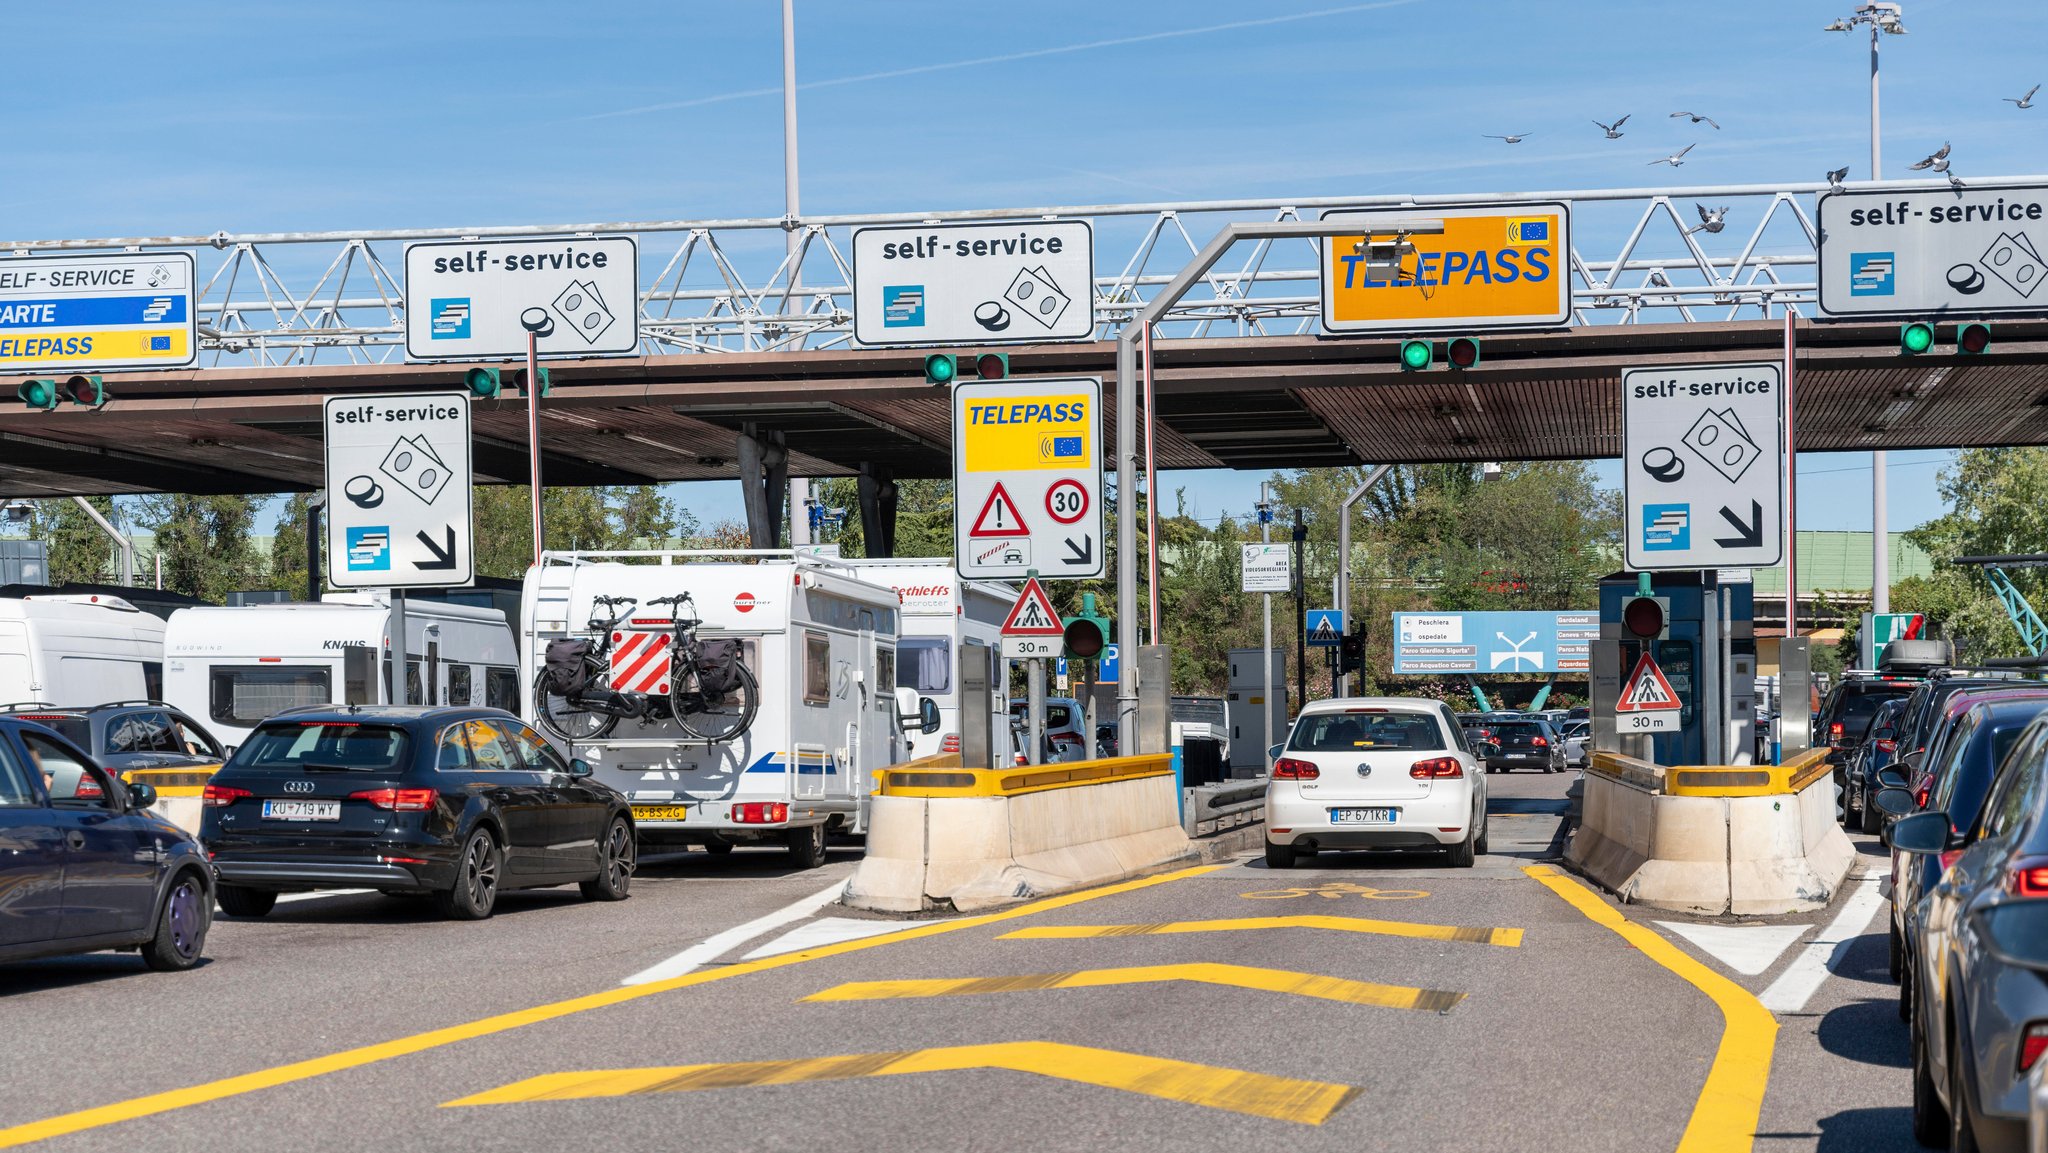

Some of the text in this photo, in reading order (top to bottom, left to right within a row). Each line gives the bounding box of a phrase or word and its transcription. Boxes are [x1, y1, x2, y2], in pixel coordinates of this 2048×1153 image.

[1850, 197, 2043, 226] self-service
[882, 232, 1063, 260] self-service
[433, 247, 608, 274] self-service
[0, 269, 135, 289] ELF-SERVICE
[0, 304, 57, 324] ARTE
[0, 336, 94, 357] ELEPASS
[1634, 376, 1770, 399] self-service
[335, 404, 459, 424] self-service
[970, 402, 1085, 425] TELEPASS
[1054, 491, 1080, 512] 30
[322, 640, 367, 650] KNAUS
[1018, 642, 1048, 653] 30 m
[1632, 717, 1664, 728] 30 m
[272, 803, 334, 815] KU 719 WY
[1339, 809, 1389, 821] EP 671KR
